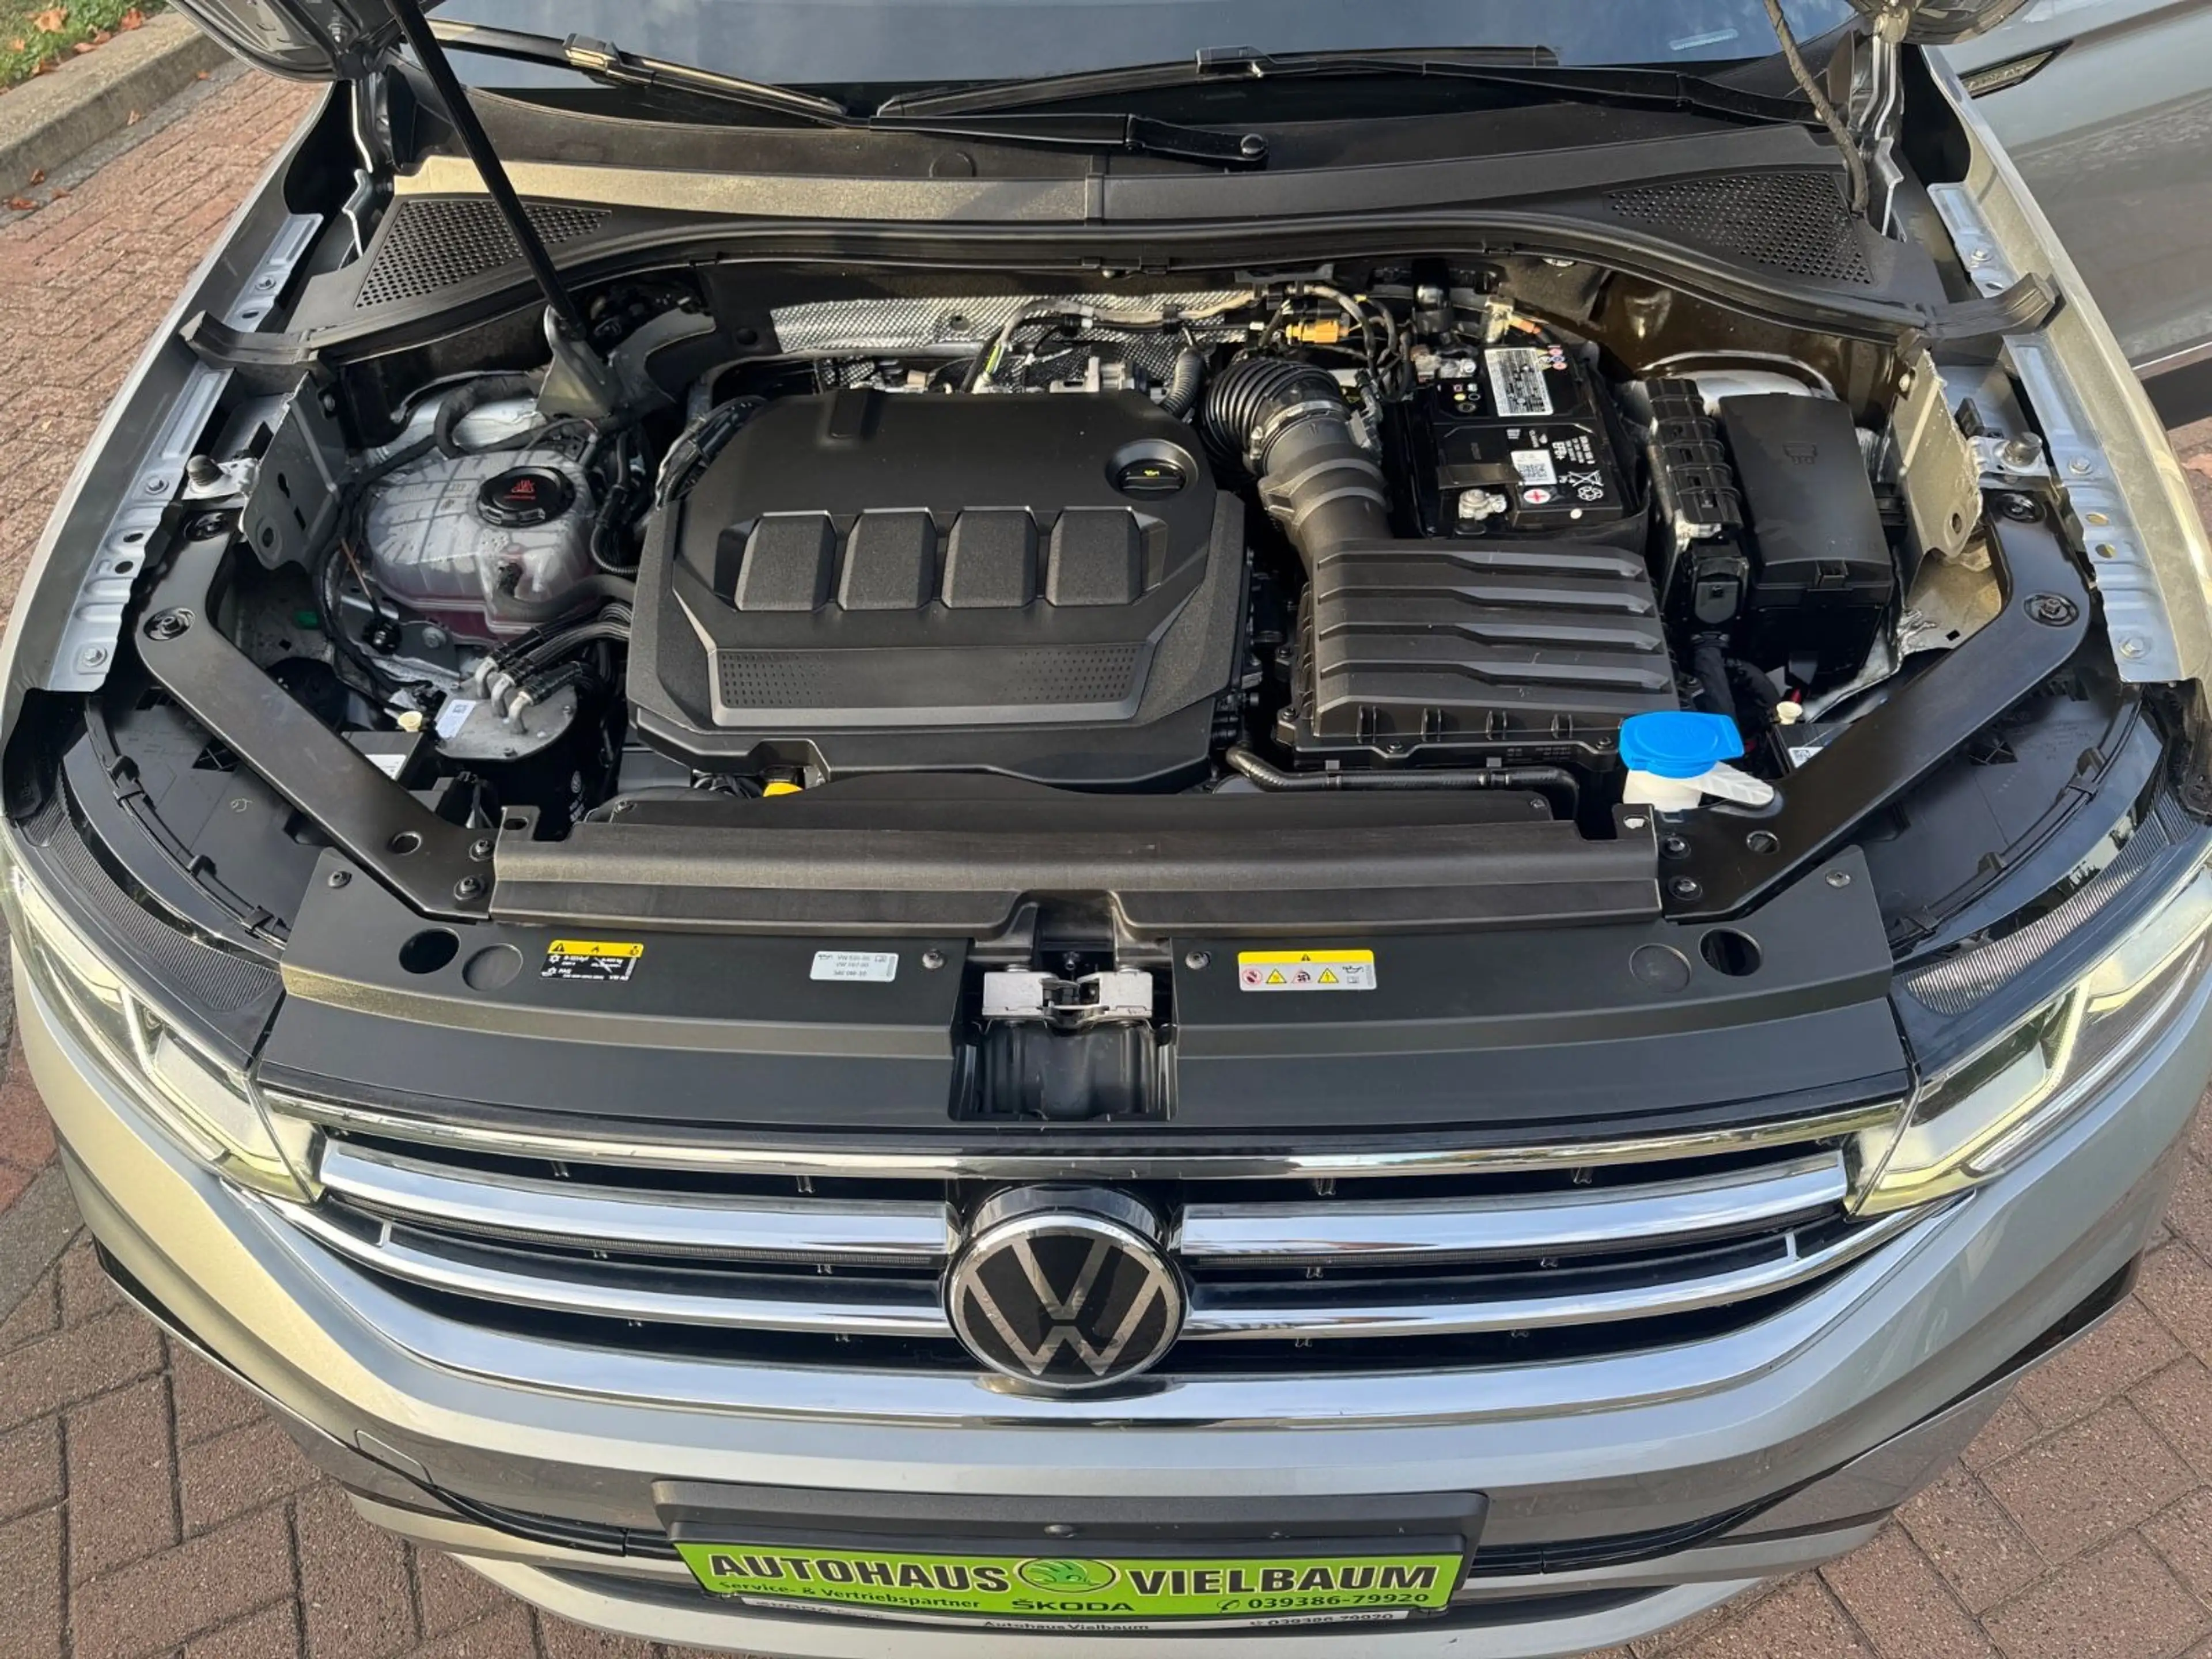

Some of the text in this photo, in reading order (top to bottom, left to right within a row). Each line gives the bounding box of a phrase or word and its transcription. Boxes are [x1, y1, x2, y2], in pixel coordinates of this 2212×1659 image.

[709, 1554, 1439, 1596] AUTOHAUS VIELBAUM
[719, 1581, 796, 1593] Service-
[802, 1586, 816, 1594] &
[821, 1588, 980, 1608] Vertriebspartner
[1012, 1598, 1136, 1612] ŠKODA
[1248, 1593, 1429, 1609] 039386-79920
